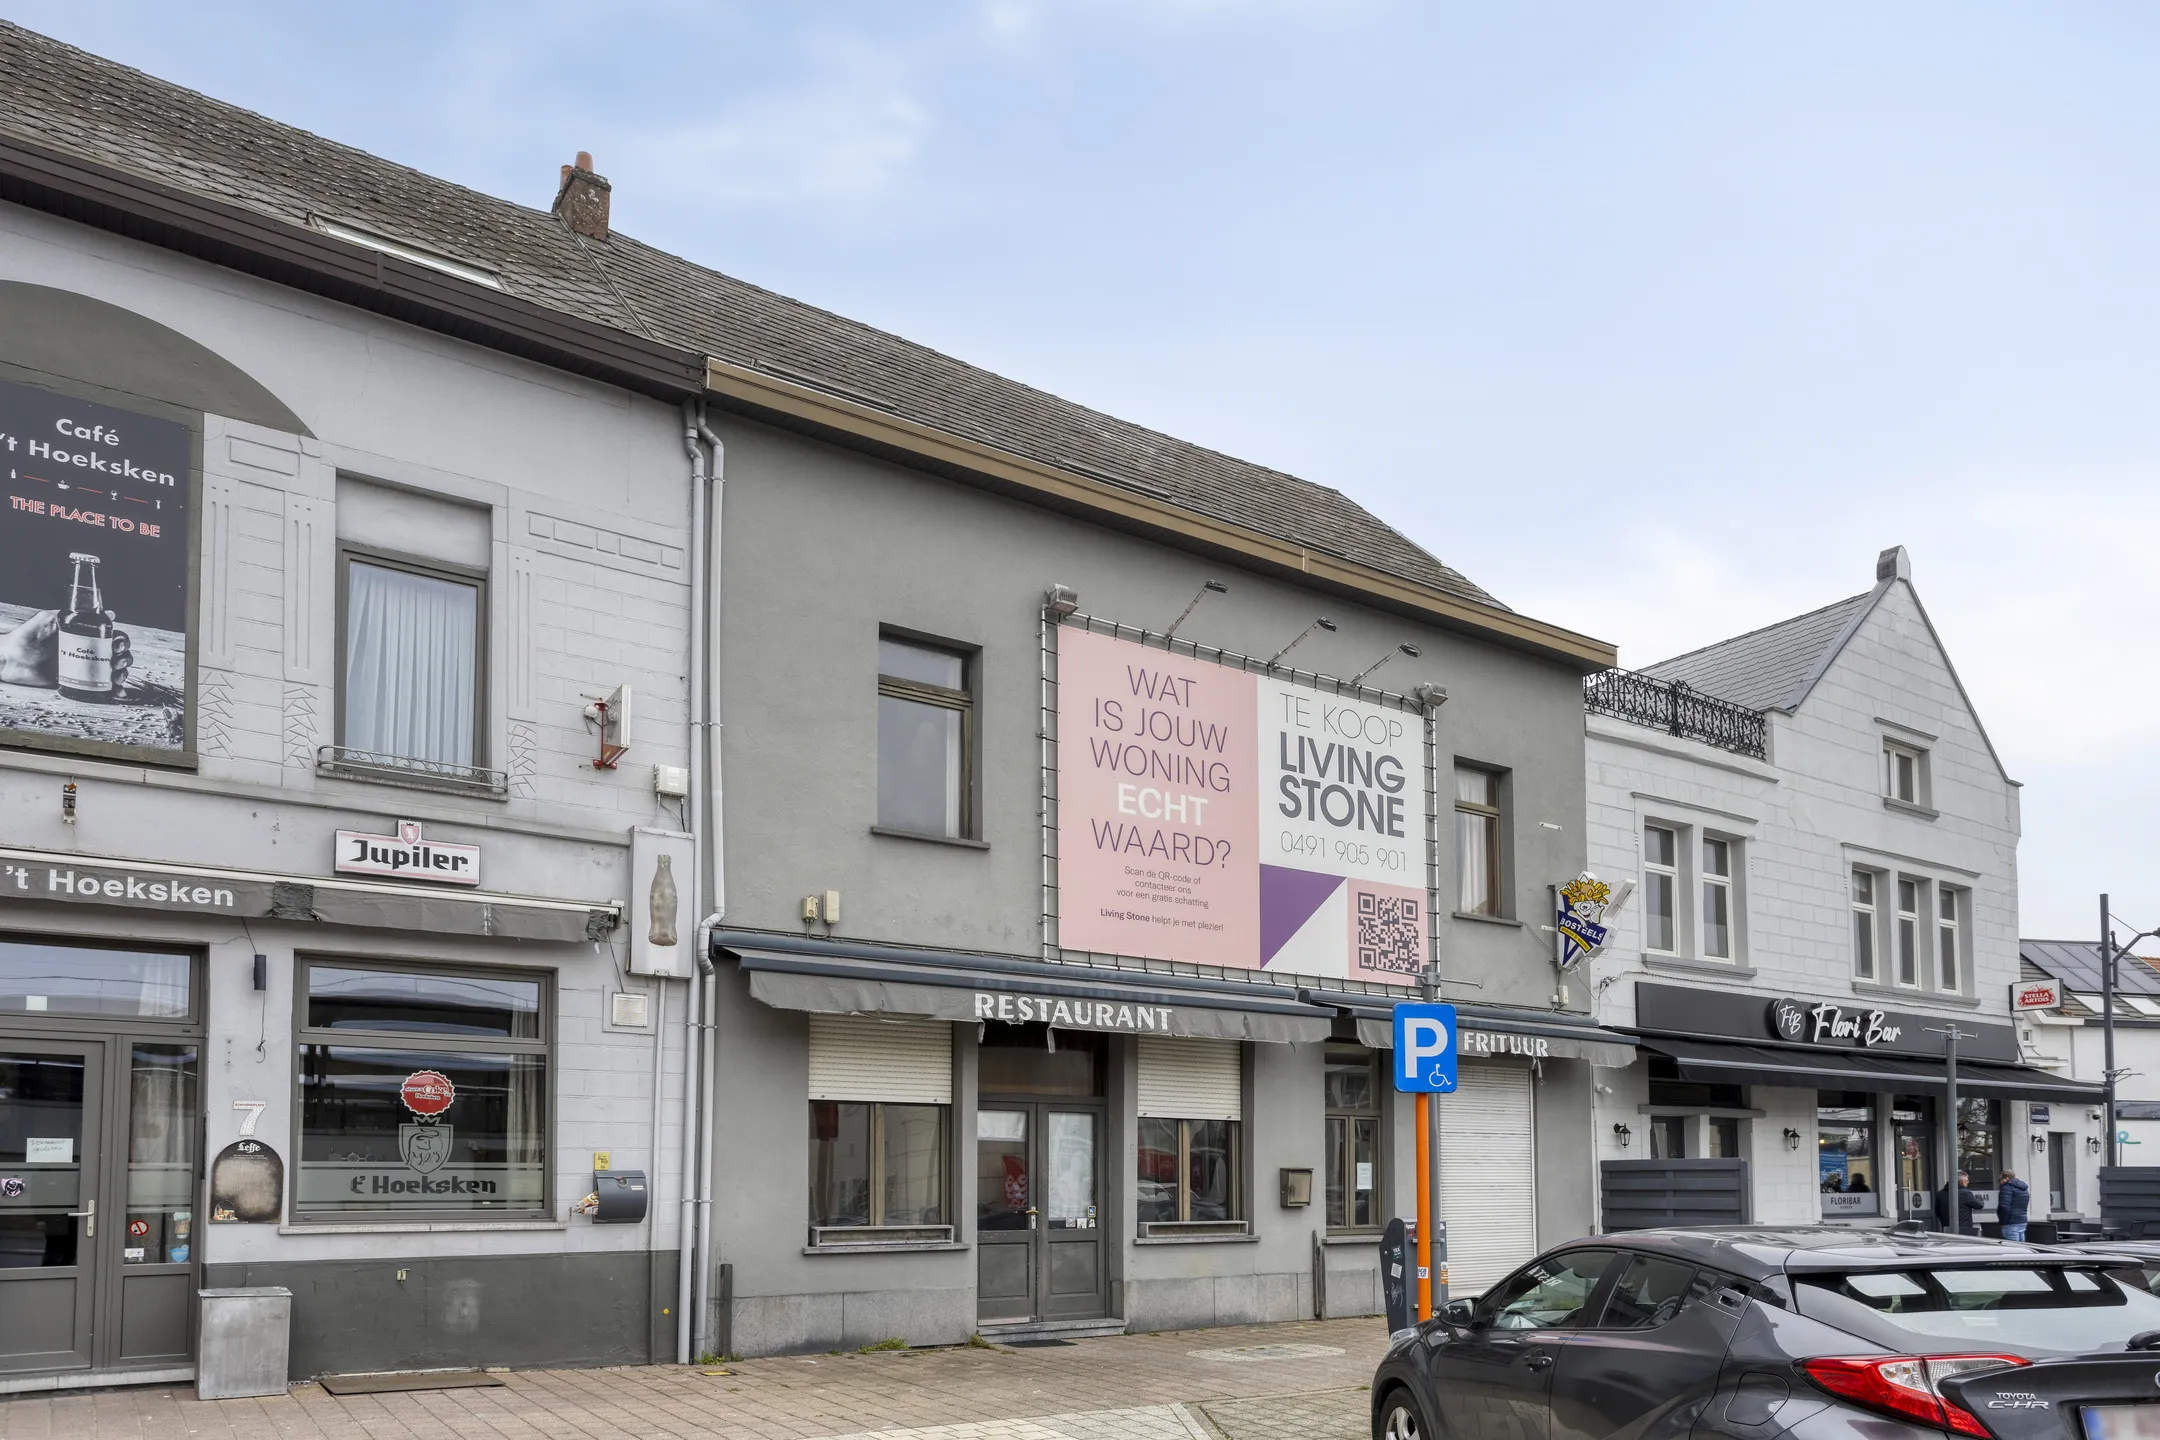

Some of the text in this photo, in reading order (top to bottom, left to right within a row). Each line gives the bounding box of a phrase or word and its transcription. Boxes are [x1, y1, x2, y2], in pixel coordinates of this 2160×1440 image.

[56, 418, 120, 446] Café
[29, 439, 175, 487] Hoeksken
[10, 495, 161, 538] THE PLACE TO BE
[1127, 665, 1197, 708] WAT
[1095, 697, 1228, 754] IS JOUW
[1279, 692, 1403, 748] TE KOOP
[1090, 736, 1230, 793] WONING
[1280, 731, 1406, 794] LIVING
[1118, 782, 1209, 826] ECHT
[1278, 774, 1405, 839] STONE
[348, 839, 469, 871] Jupiler
[1091, 818, 1231, 869] WAARD?
[1280, 830, 1406, 872] 0491 905 901
[5, 865, 234, 907] 't Hoeksken
[1124, 865, 1201, 885] Scan de QR-code of
[1135, 880, 1176, 892] contacteer
[1100, 908, 1125, 921] Living
[1126, 911, 1151, 923] Stone
[1151, 914, 1171, 926] helpt
[1173, 917, 1180, 927] je
[1181, 919, 1196, 928] met
[1116, 889, 1209, 910] voor een gratis schatting
[1560, 916, 1603, 941] BOSTEELS
[974, 992, 1173, 1030] RESTAURANT
[1812, 1001, 1902, 1047] Flori Bar
[1404, 1017, 1449, 1078] P
[1463, 1031, 1549, 1057] FRITUUR
[233, 1100, 267, 1136] 7
[237, 1142, 262, 1154] Leffe
[372, 1175, 496, 1194] Hoeksken
[1830, 1196, 1861, 1205] FLORIBAR
[1987, 1400, 2050, 1410] C-HR
[1996, 1392, 2037, 1400] TOYOTA
